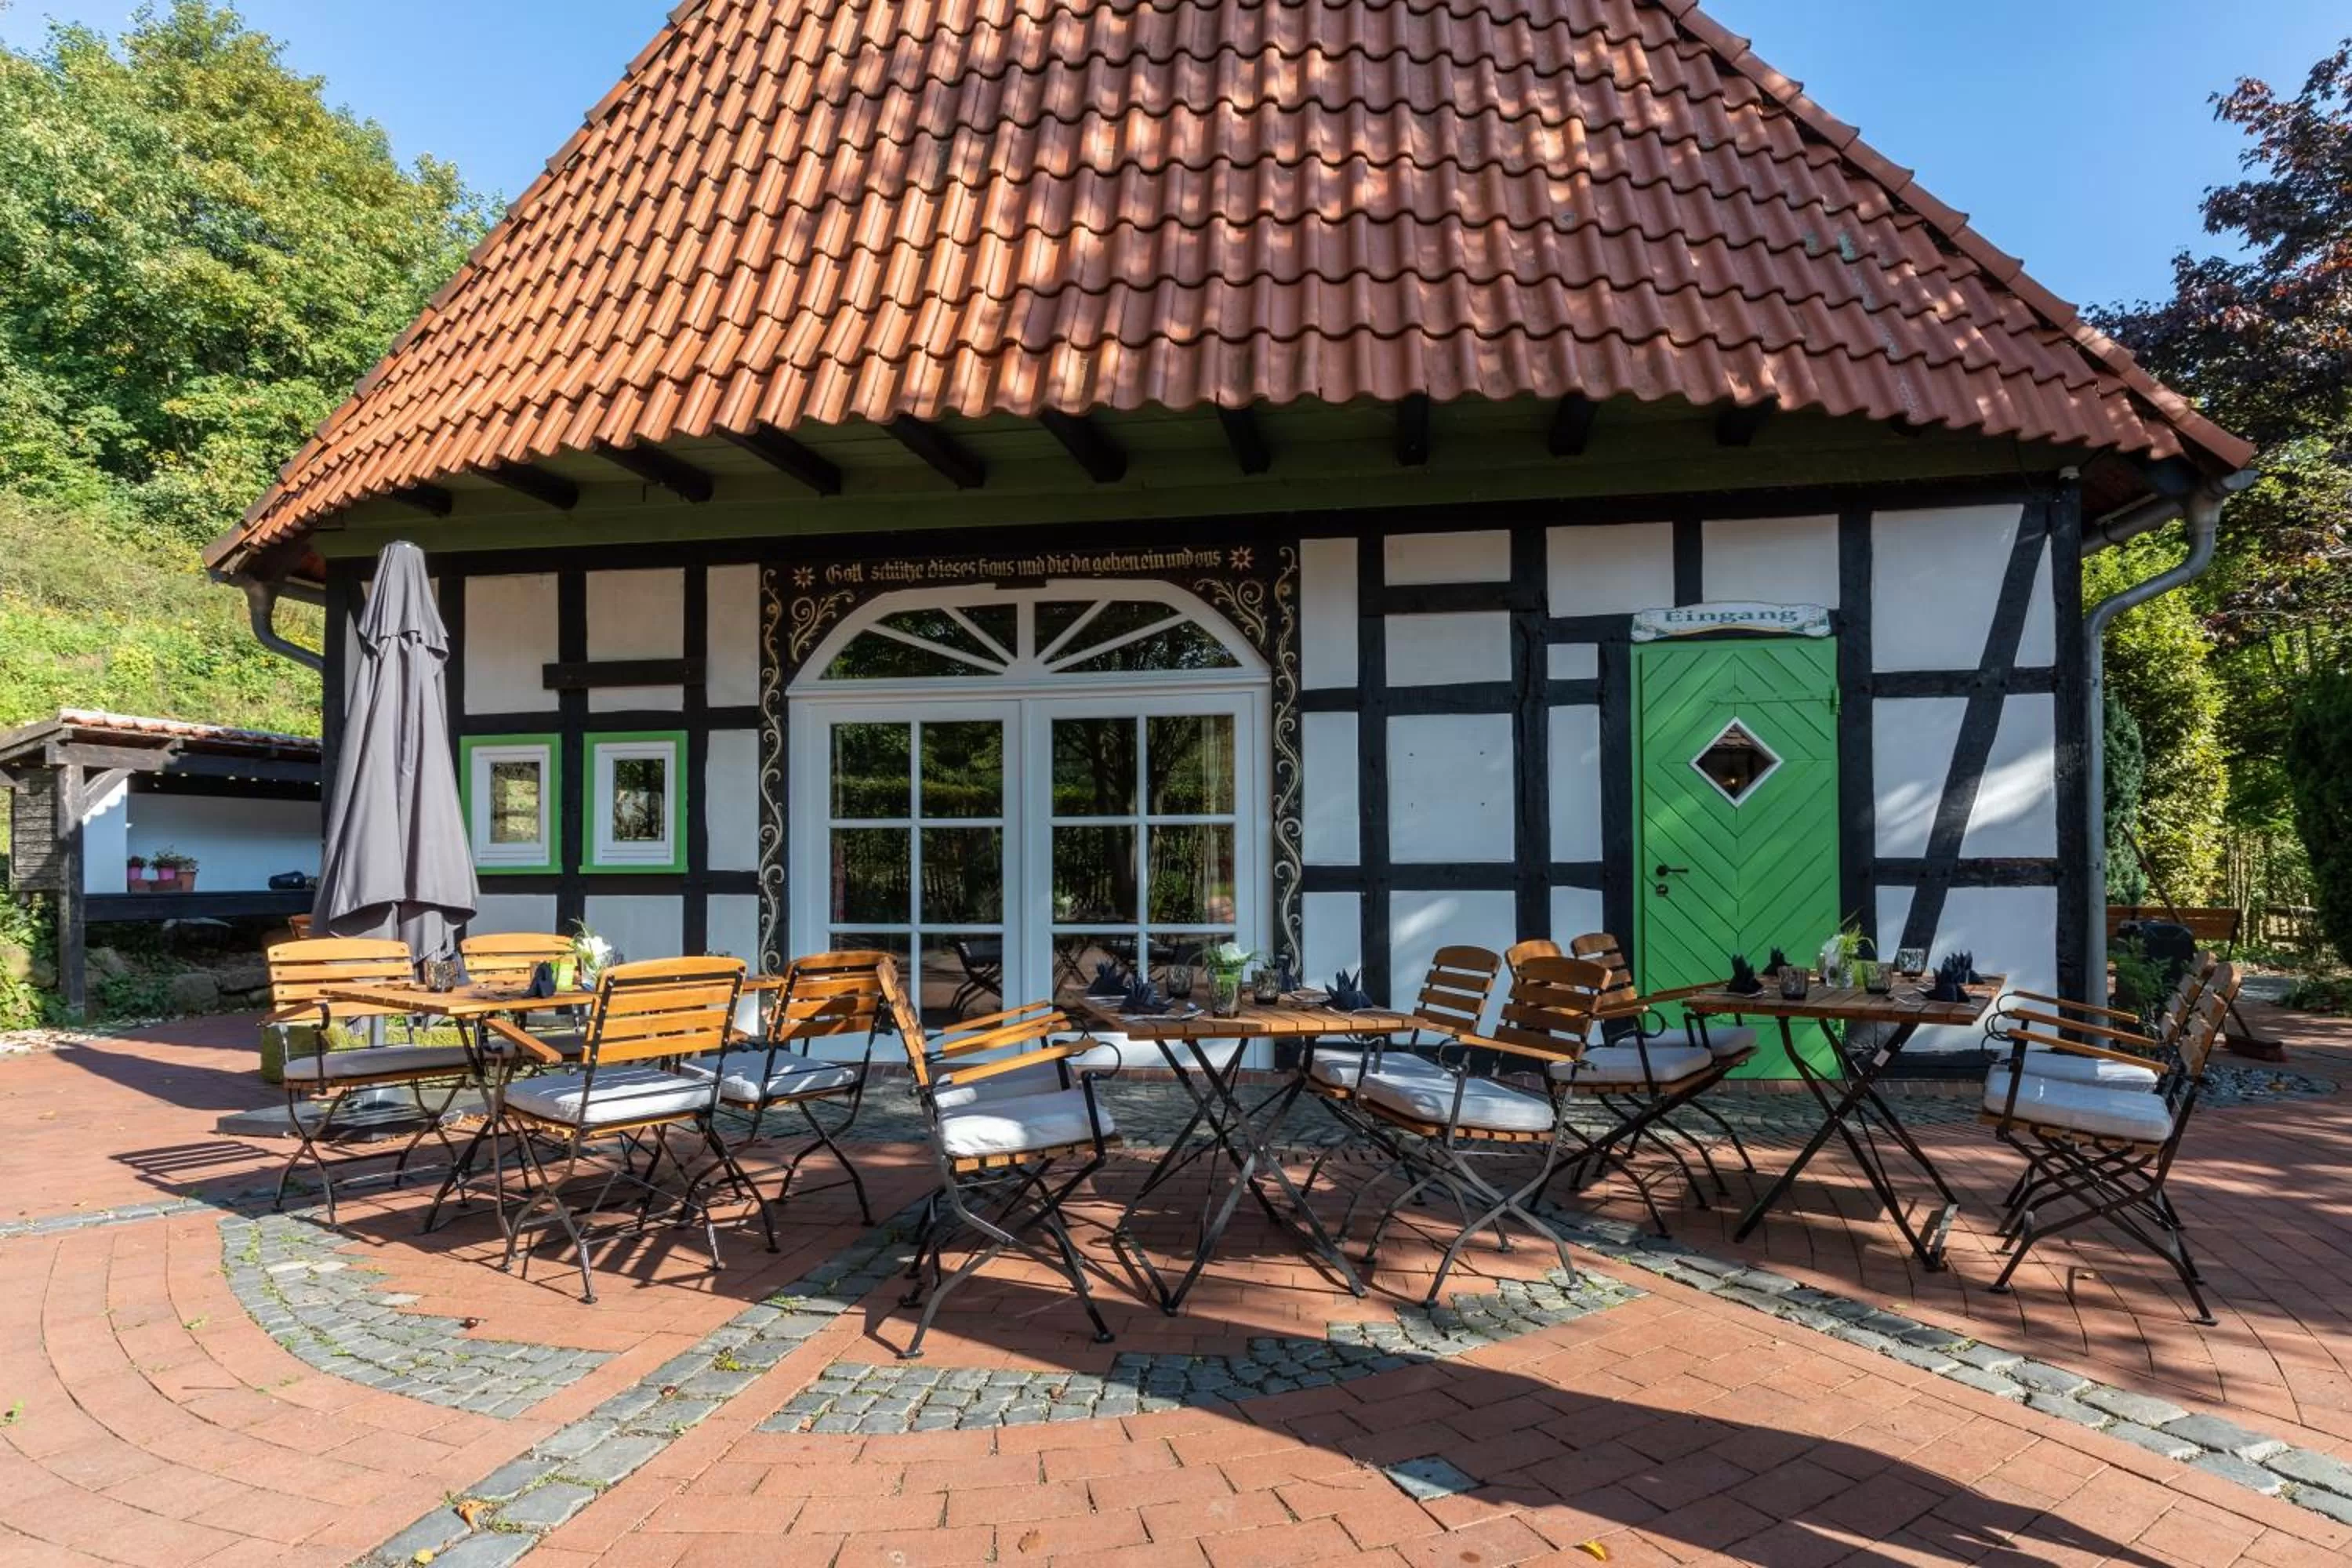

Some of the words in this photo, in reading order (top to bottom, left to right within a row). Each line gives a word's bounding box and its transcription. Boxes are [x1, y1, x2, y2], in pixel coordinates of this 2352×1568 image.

[826, 562, 863, 583] Gott
[870, 559, 924, 582] schütze
[927, 558, 977, 578] dieses
[1018, 555, 1045, 575] und
[1047, 554, 1070, 574] die
[1070, 554, 1091, 572] da
[1093, 551, 1140, 575] gehen
[1141, 550, 1165, 570] ein
[1166, 547, 1193, 568] und
[1194, 550, 1221, 568] aus
[1664, 609, 1798, 623] Eingang
